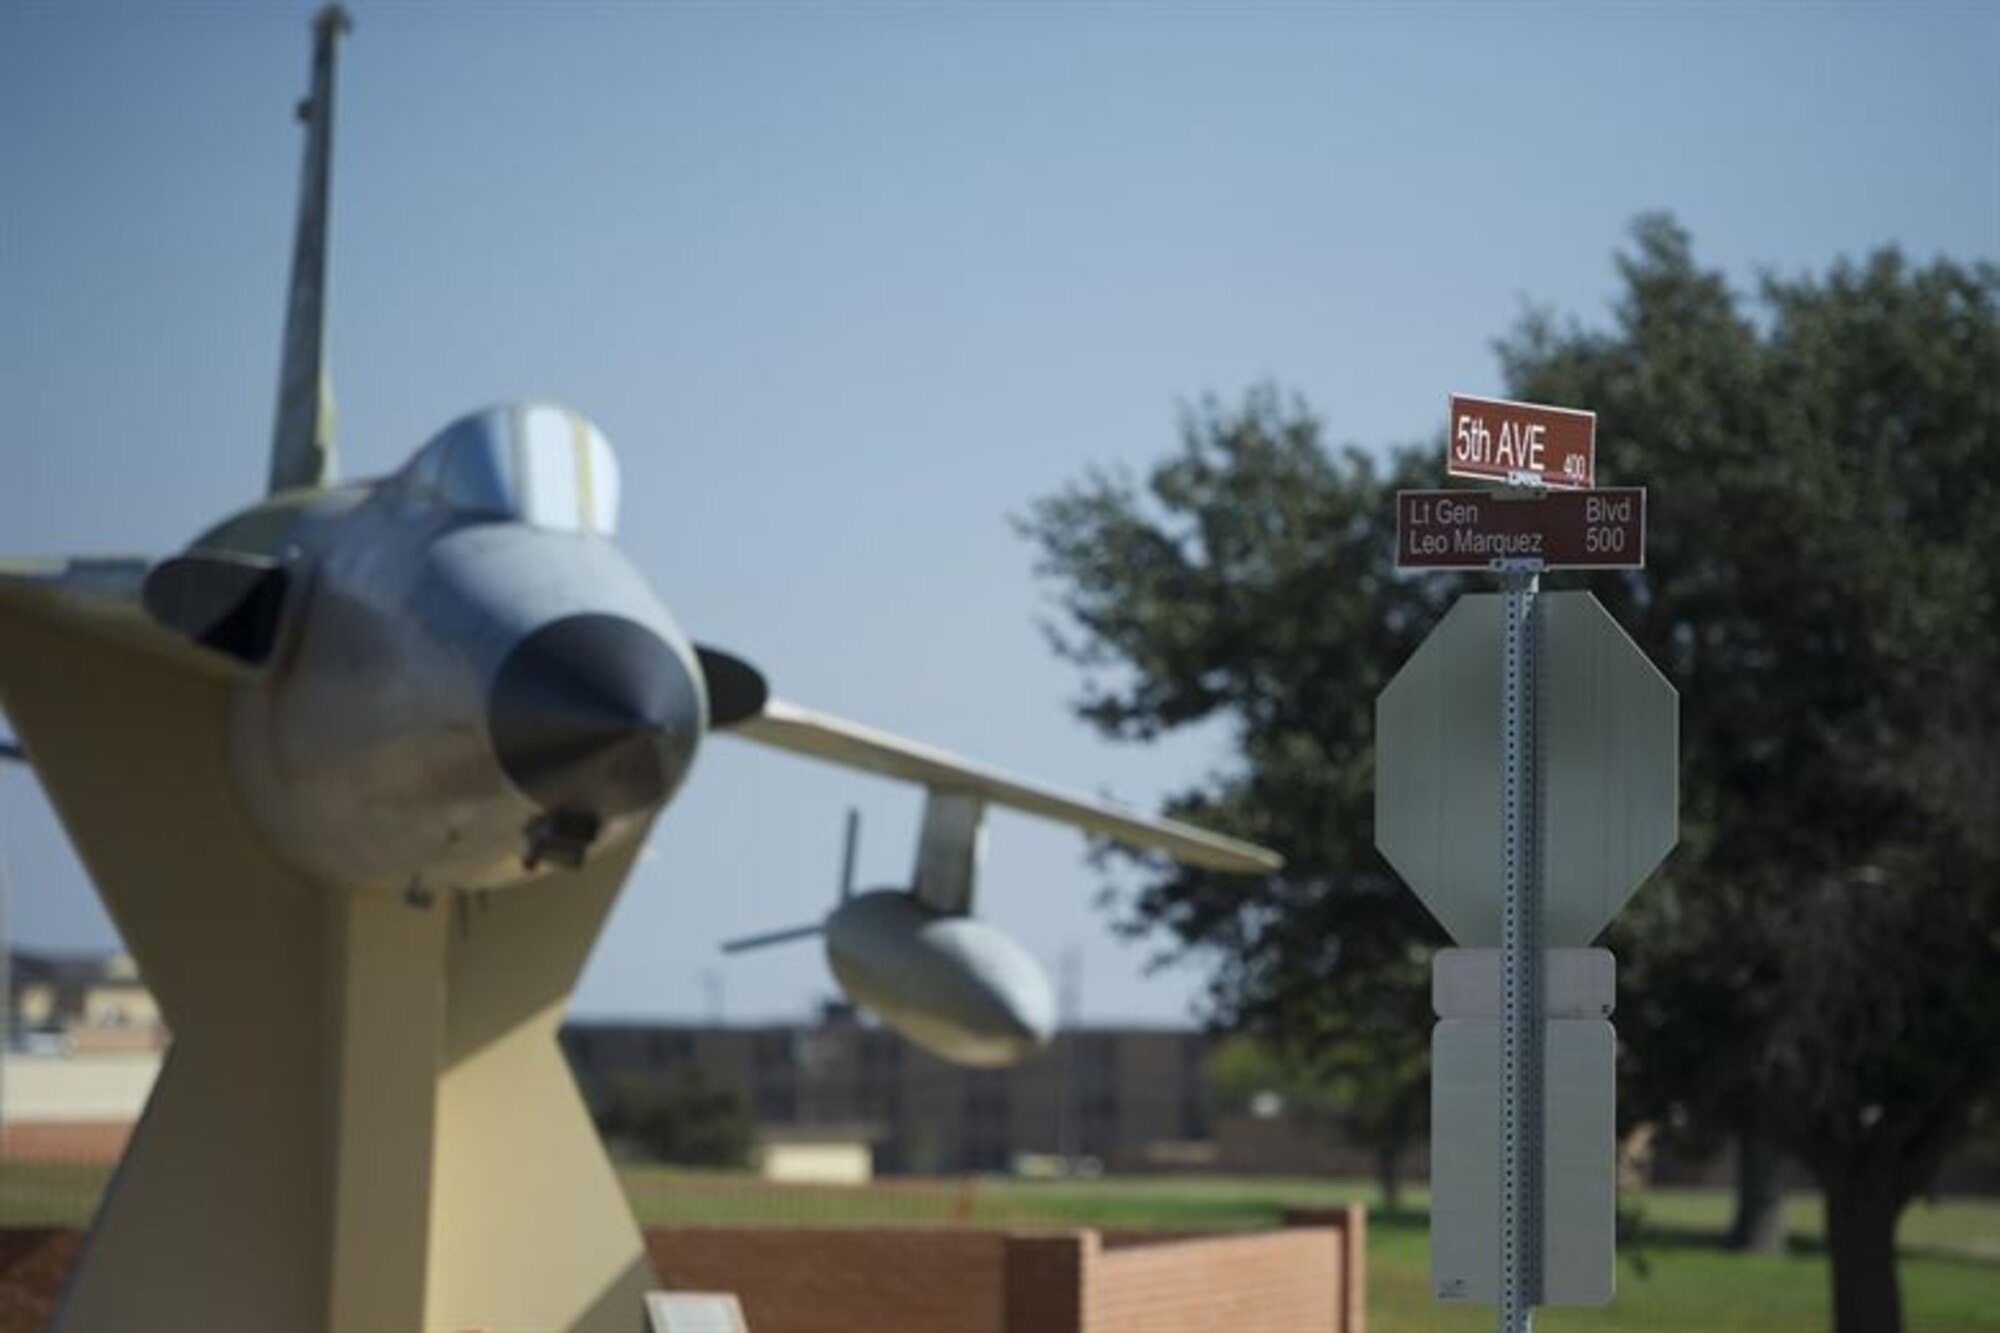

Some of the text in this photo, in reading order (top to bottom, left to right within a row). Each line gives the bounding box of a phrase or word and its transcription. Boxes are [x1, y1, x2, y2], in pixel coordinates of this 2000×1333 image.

[1456, 415, 1546, 470] 5th AVE
[1563, 453, 1586, 480] 400
[1410, 499, 1479, 525] Lt Gen
[1586, 497, 1631, 523] Blvd
[1410, 529, 1543, 559] Leo Marquez
[1586, 528, 1625, 552] 500
